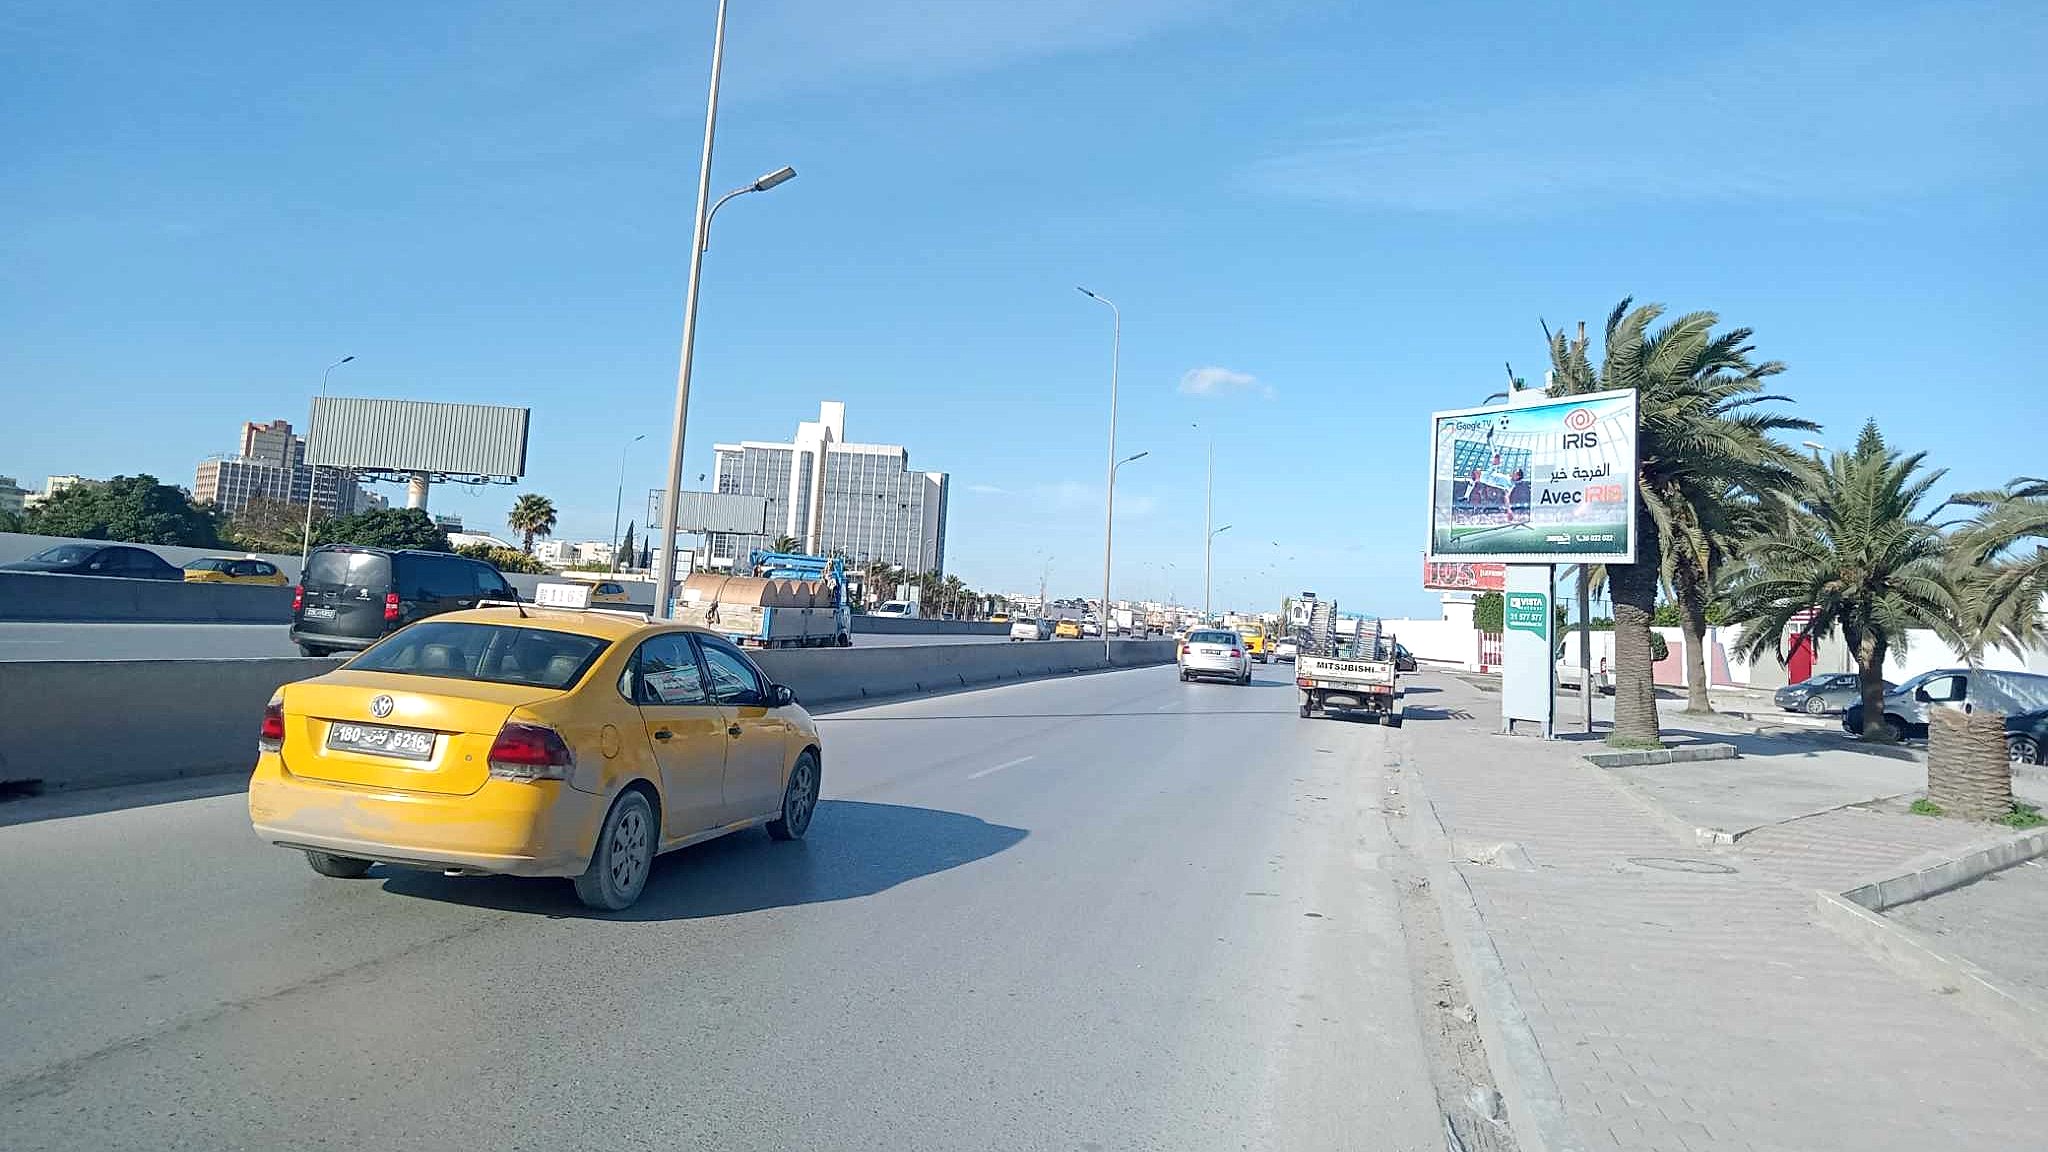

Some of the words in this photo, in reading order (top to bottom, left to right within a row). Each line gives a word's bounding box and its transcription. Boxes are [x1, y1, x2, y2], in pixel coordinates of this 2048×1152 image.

[1563, 431, 1597, 450] IRIS
[1550, 467, 1568, 484] خير
[1572, 462, 1610, 481] الفرجة
[1540, 489, 1582, 504] Avec
[1316, 661, 1375, 673] MITSUBISHI
[339, 726, 361, 742] 180
[393, 733, 426, 750] 6216
